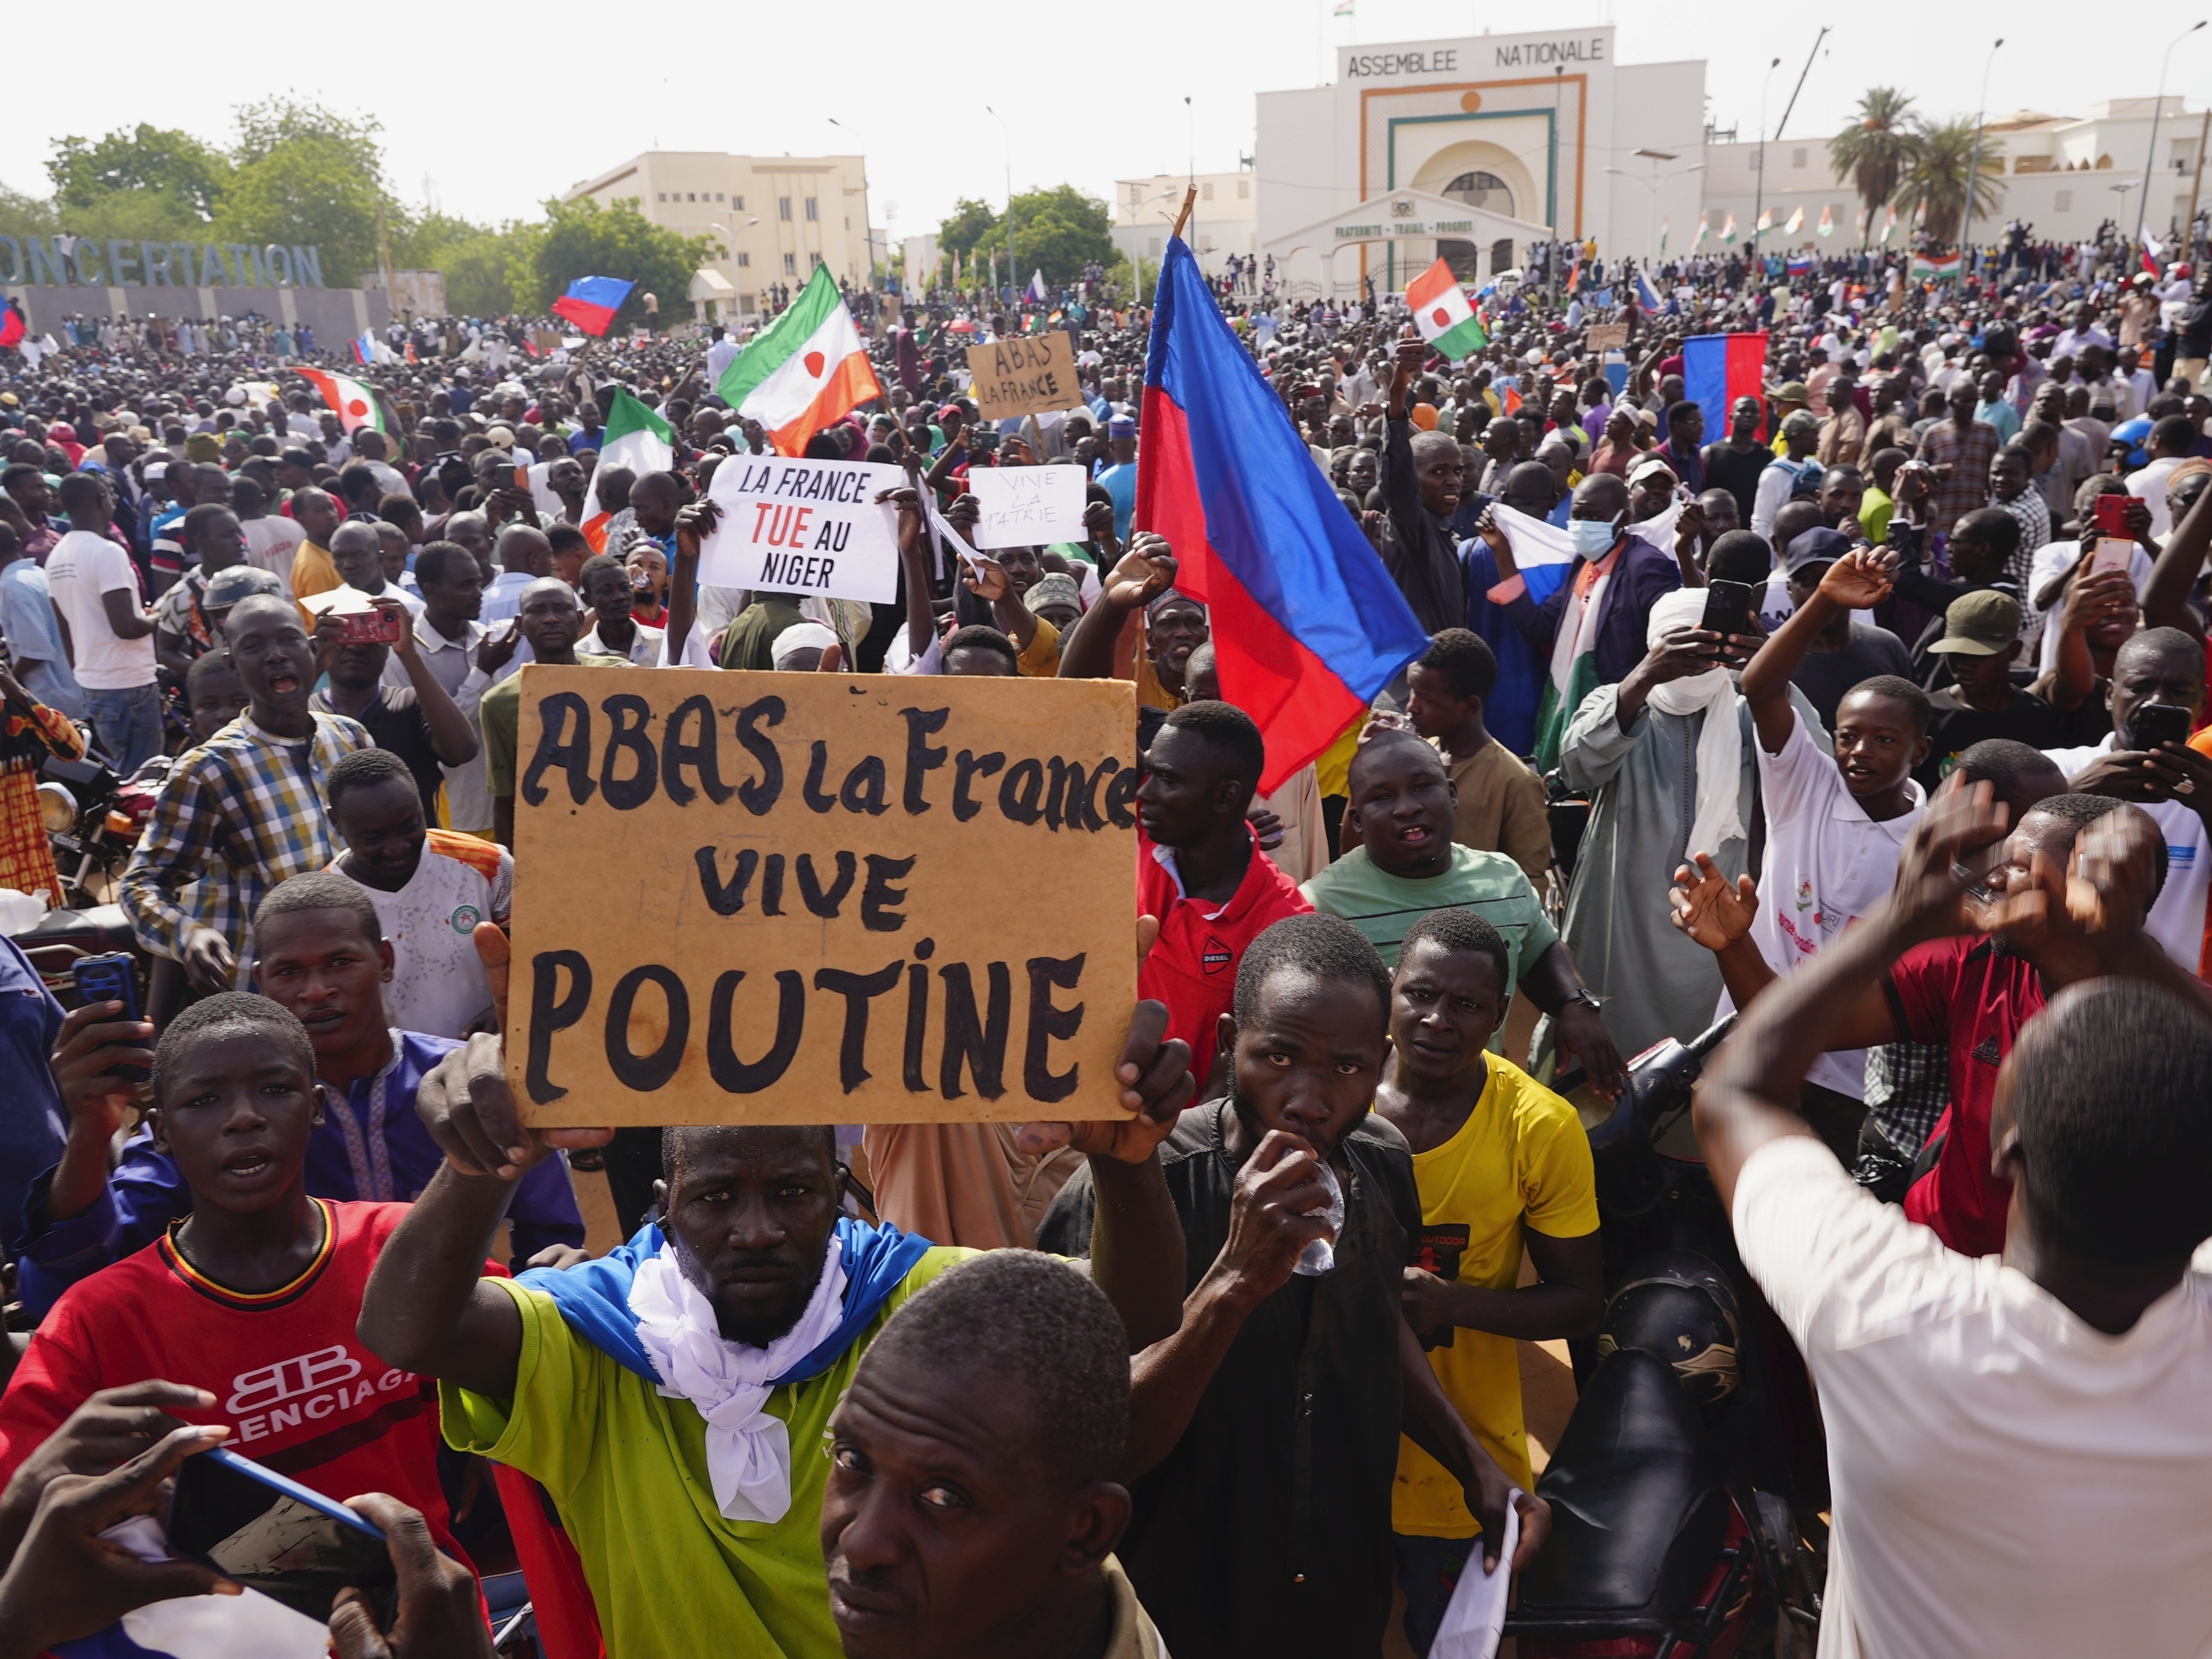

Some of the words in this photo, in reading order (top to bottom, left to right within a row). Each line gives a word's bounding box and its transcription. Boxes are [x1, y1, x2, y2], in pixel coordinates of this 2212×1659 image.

[1348, 50, 1458, 78] ASSEMBLEE
[1495, 39, 1604, 67] NATIONALE
[995, 335, 1052, 377] ABAS
[738, 465, 771, 493] LA
[773, 468, 871, 504] FRANCE
[998, 472, 1056, 490] VIVE
[1011, 493, 1041, 508] LA
[752, 502, 814, 549] TUE
[814, 520, 851, 552] AU
[985, 506, 1056, 530] PATRIE
[759, 552, 835, 588] NIGER
[522, 691, 786, 816] ABAS
[897, 706, 1138, 833] France
[694, 845, 917, 932] VIVE
[1420, 1235, 1466, 1246] OUTDOOR
